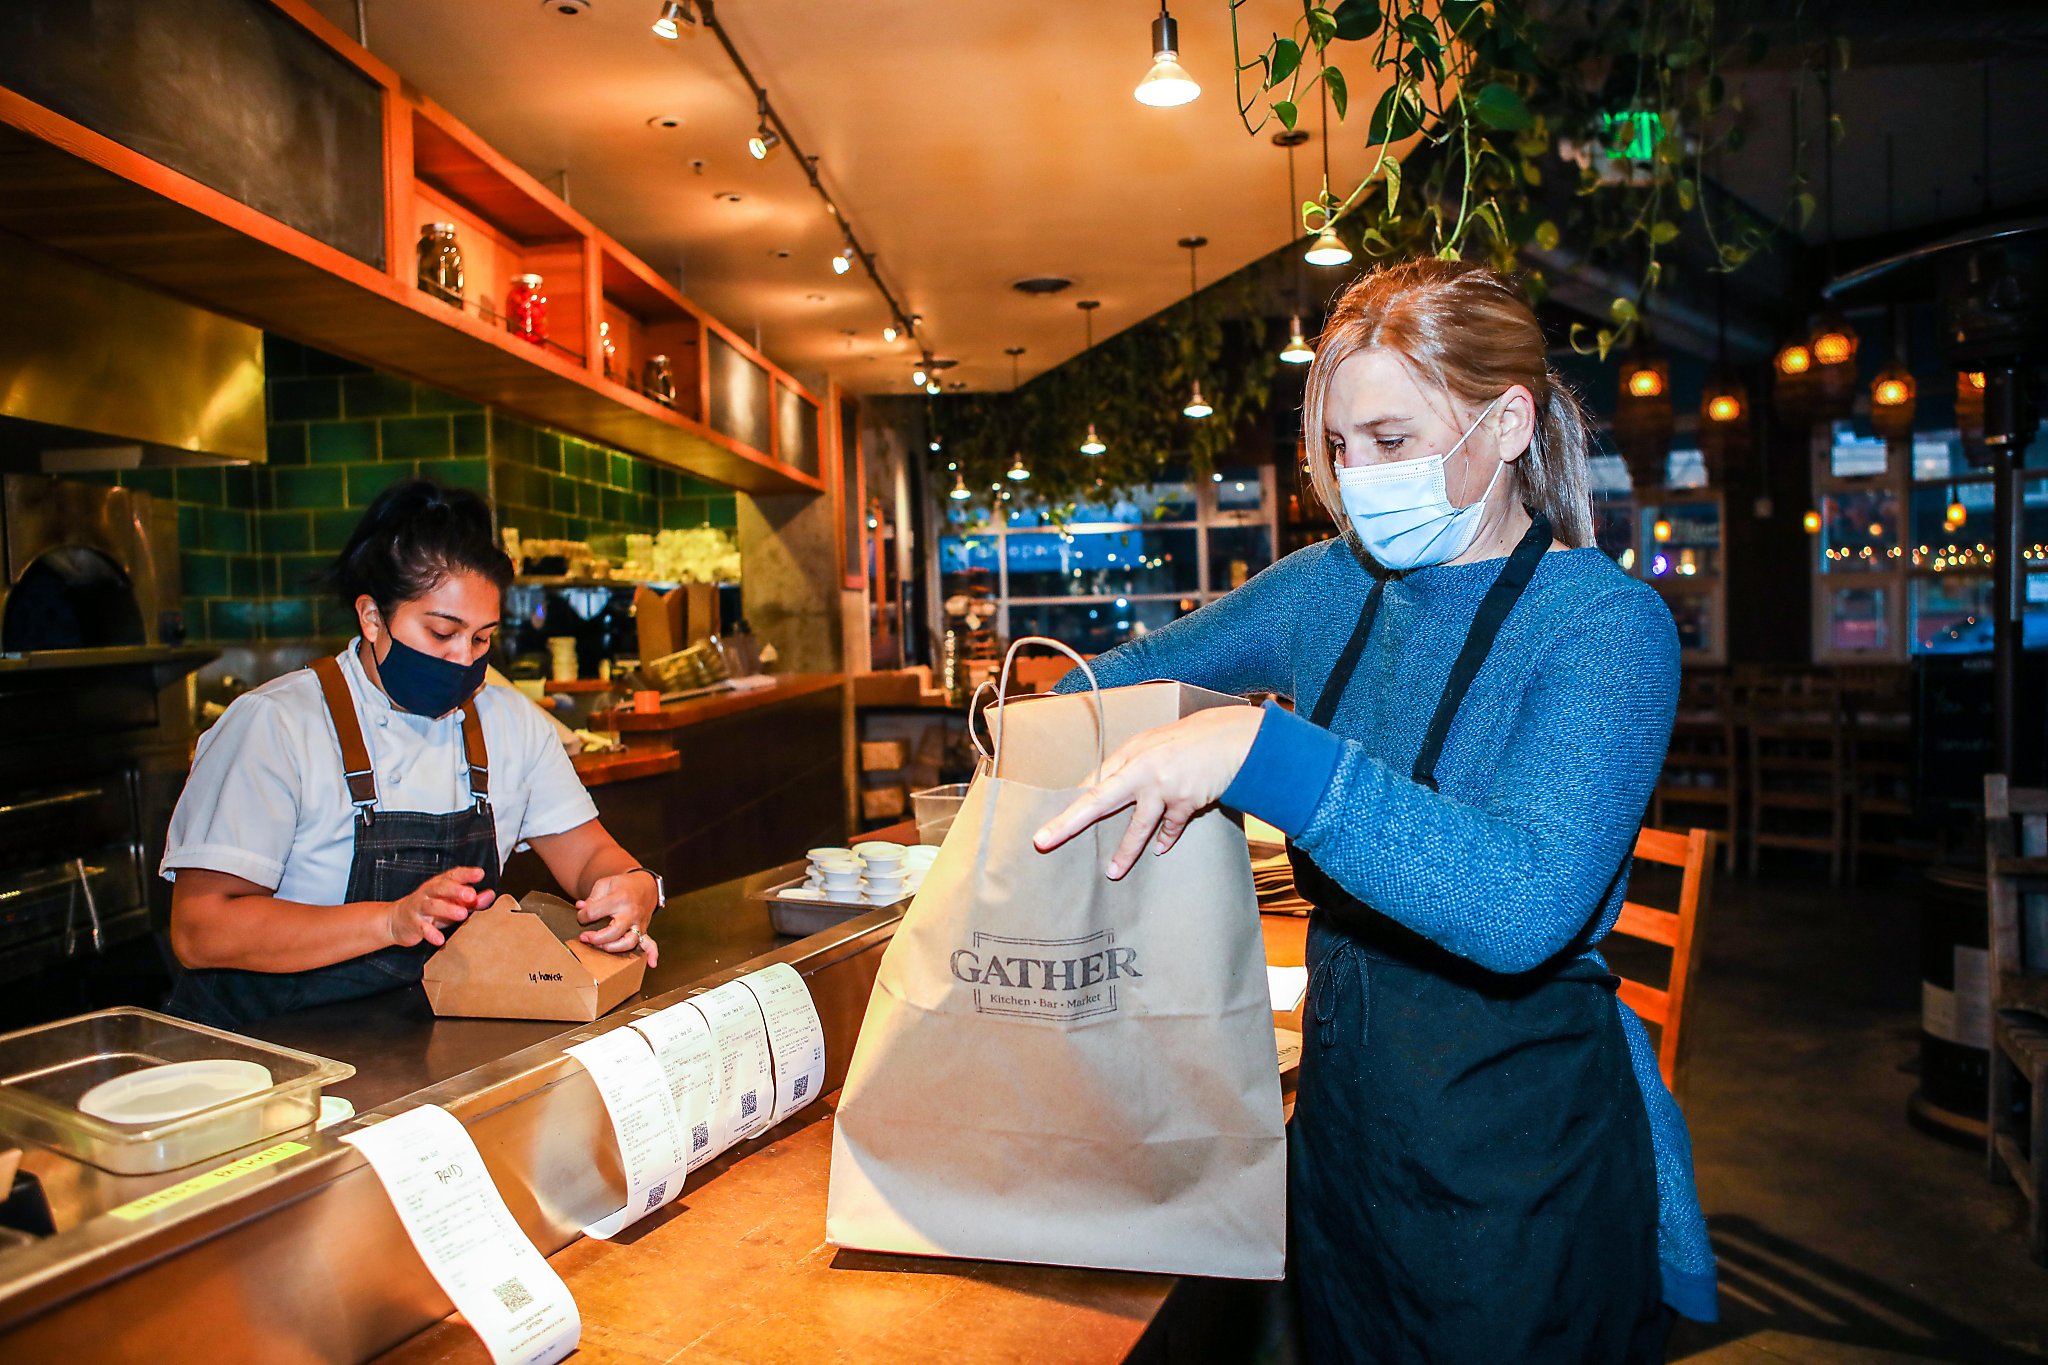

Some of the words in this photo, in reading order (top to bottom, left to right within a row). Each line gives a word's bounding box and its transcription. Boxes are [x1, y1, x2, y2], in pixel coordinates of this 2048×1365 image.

[949, 946, 1143, 992] GATHER
[990, 993, 1031, 1006] Kitchen
[1039, 998, 1058, 1009] Bar
[1067, 993, 1101, 1009] Market
[434, 1163, 463, 1184] PAID
